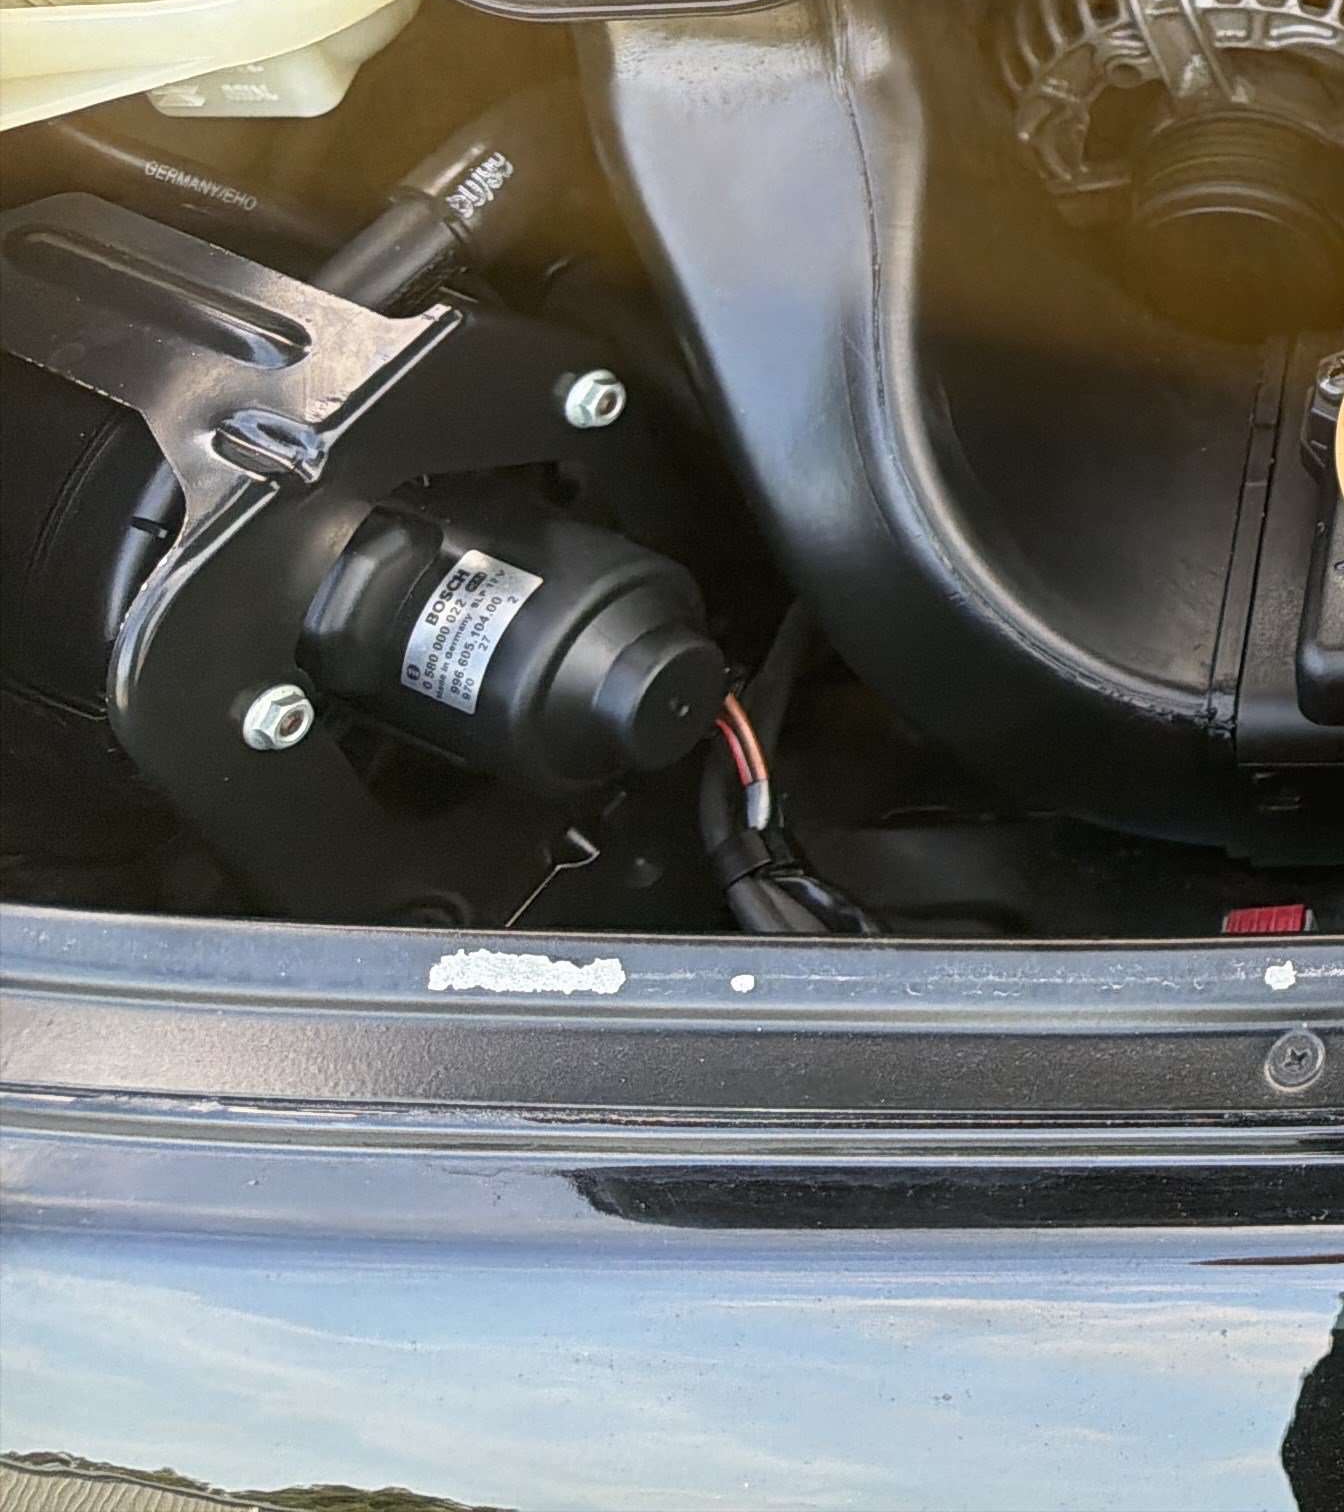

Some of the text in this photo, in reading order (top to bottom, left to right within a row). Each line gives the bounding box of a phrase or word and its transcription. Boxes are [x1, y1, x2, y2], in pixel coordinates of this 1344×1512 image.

[425, 568, 471, 626] BOSCH
[478, 635, 492, 651] 27
[507, 595, 519, 605] 2
[422, 598, 467, 690] 0 580 000 022
[445, 613, 473, 660] Germany
[451, 596, 503, 695] 996.605.104.00
